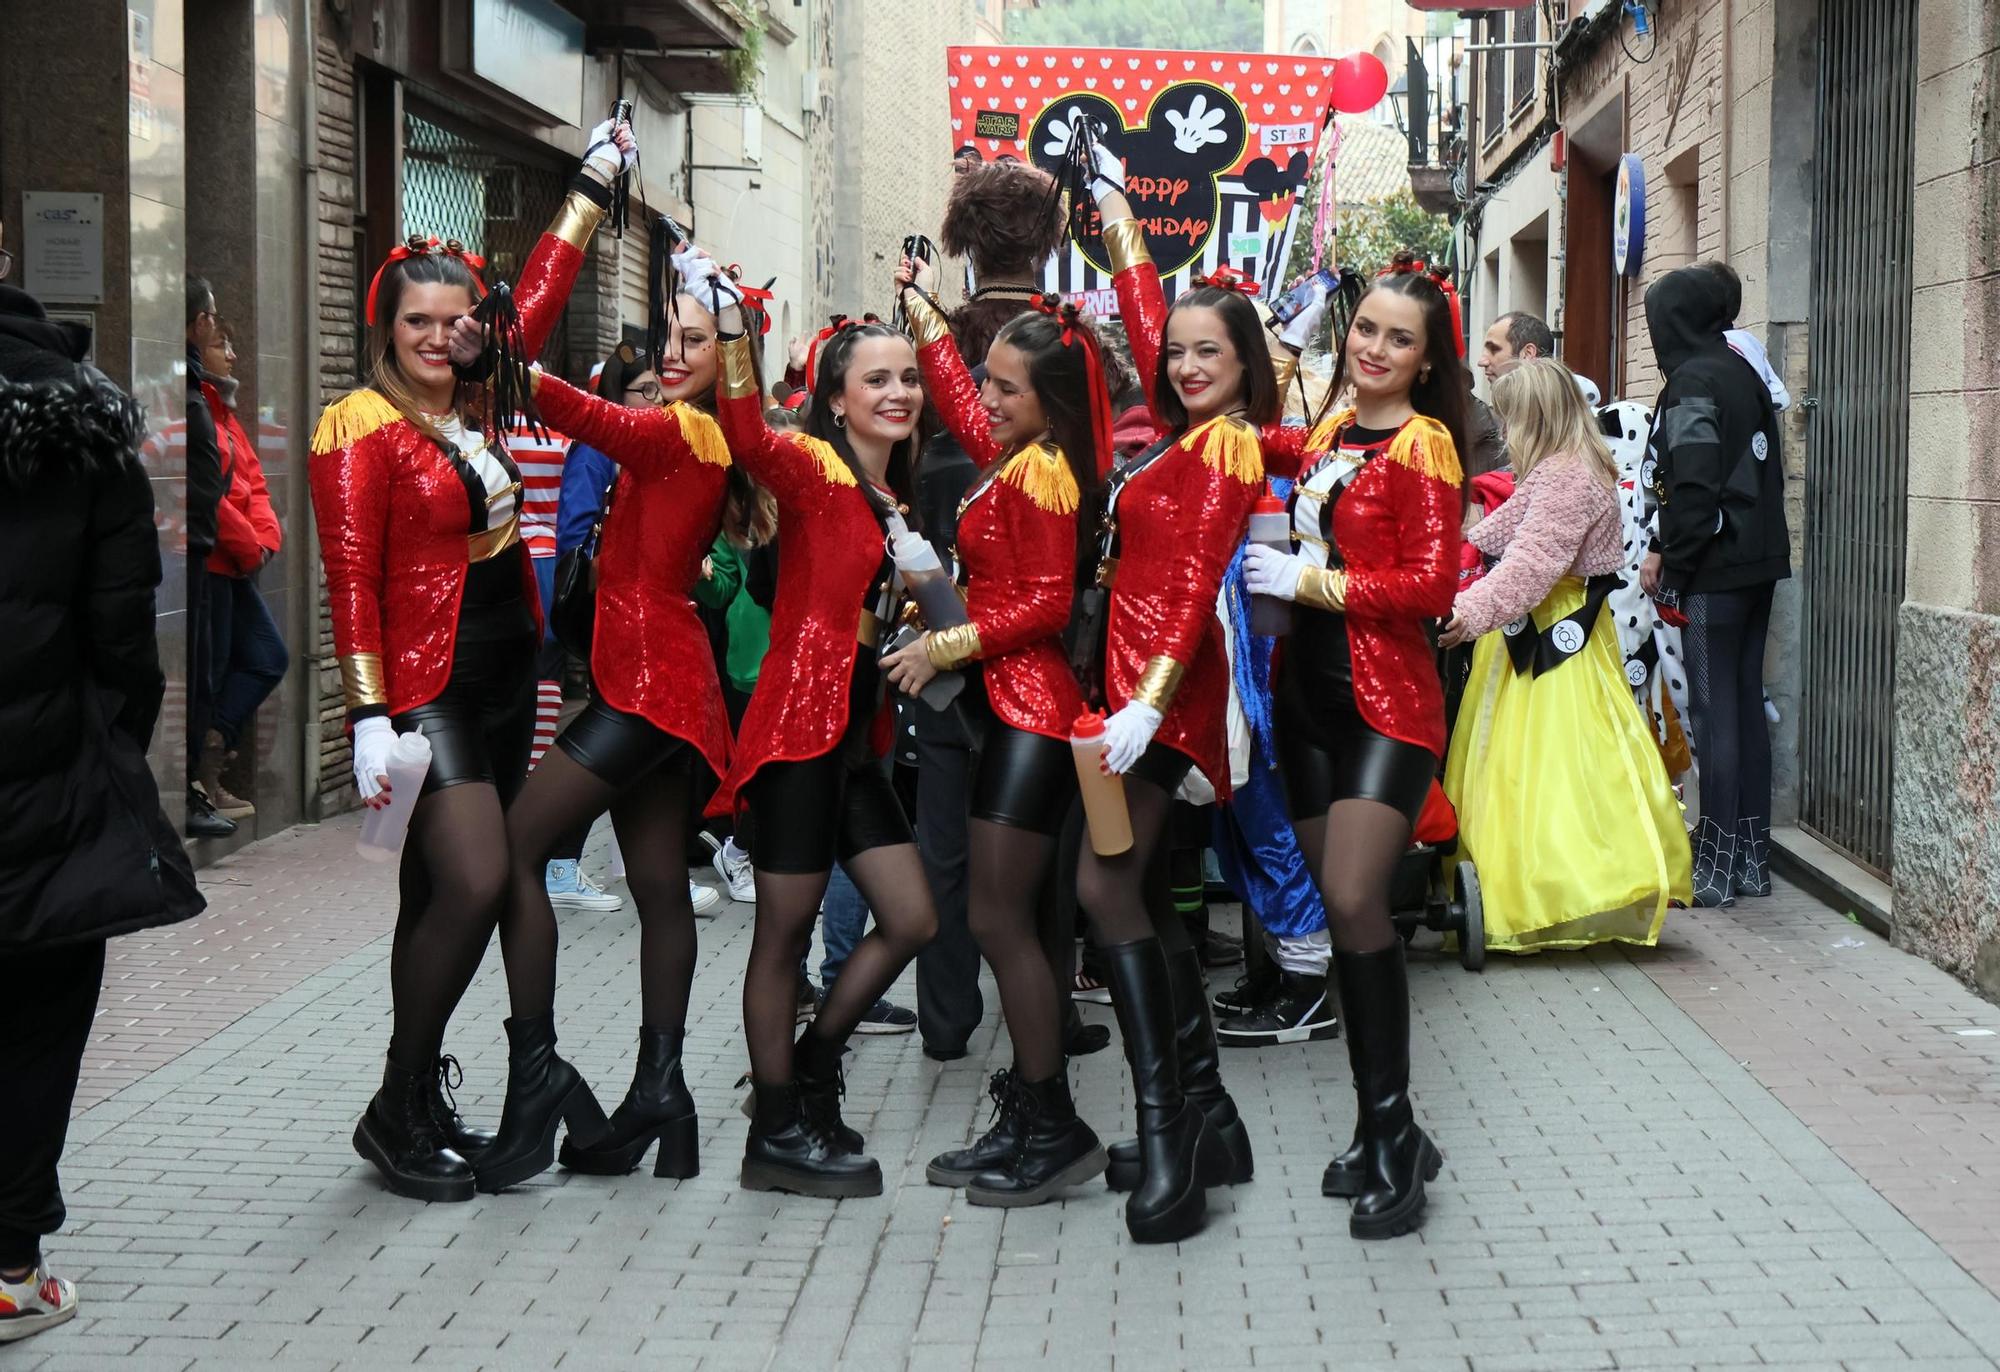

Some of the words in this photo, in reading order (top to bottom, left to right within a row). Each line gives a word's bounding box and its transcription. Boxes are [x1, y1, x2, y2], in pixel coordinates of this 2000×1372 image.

[977, 114, 1016, 127] STAR
[977, 122, 1018, 137] WARS
[1555, 626, 1577, 651] 100
[1629, 665, 1646, 683] 100
